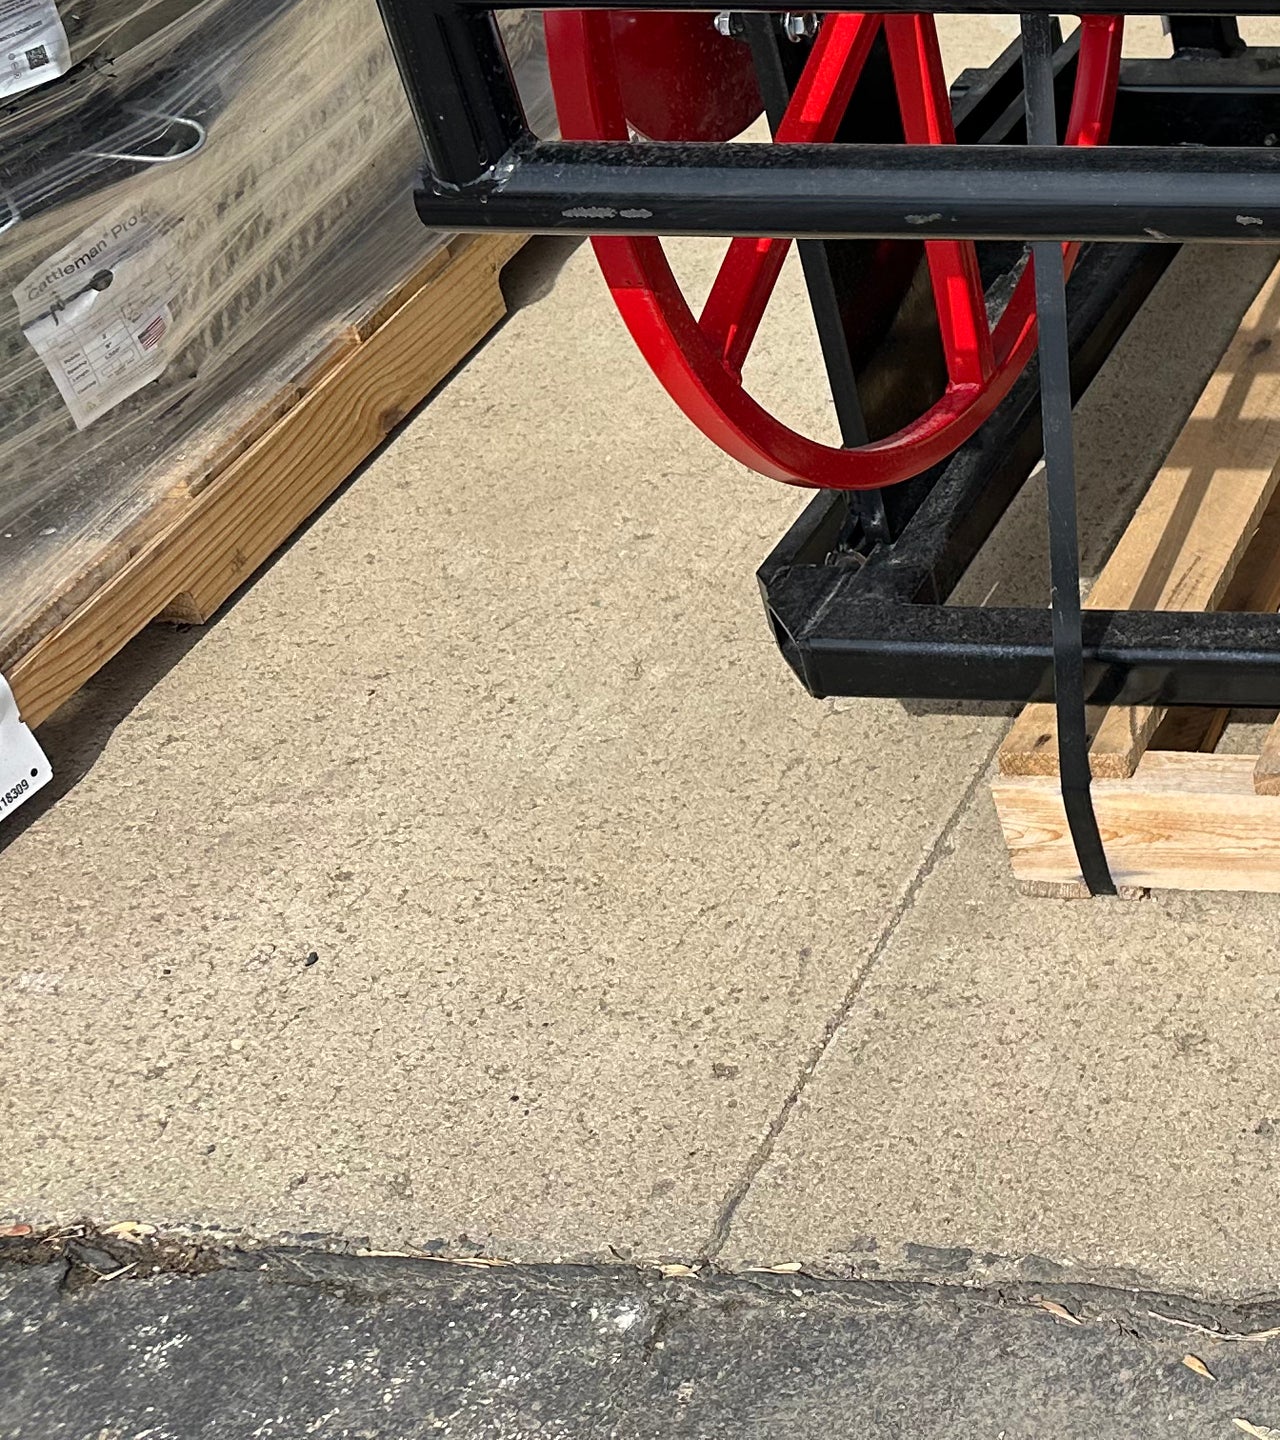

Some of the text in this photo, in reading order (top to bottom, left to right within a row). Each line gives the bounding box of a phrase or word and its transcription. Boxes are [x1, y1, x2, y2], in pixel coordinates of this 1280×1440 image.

[27, 214, 139, 302] Cattleman Pro
[0, 778, 30, 811] 18309
